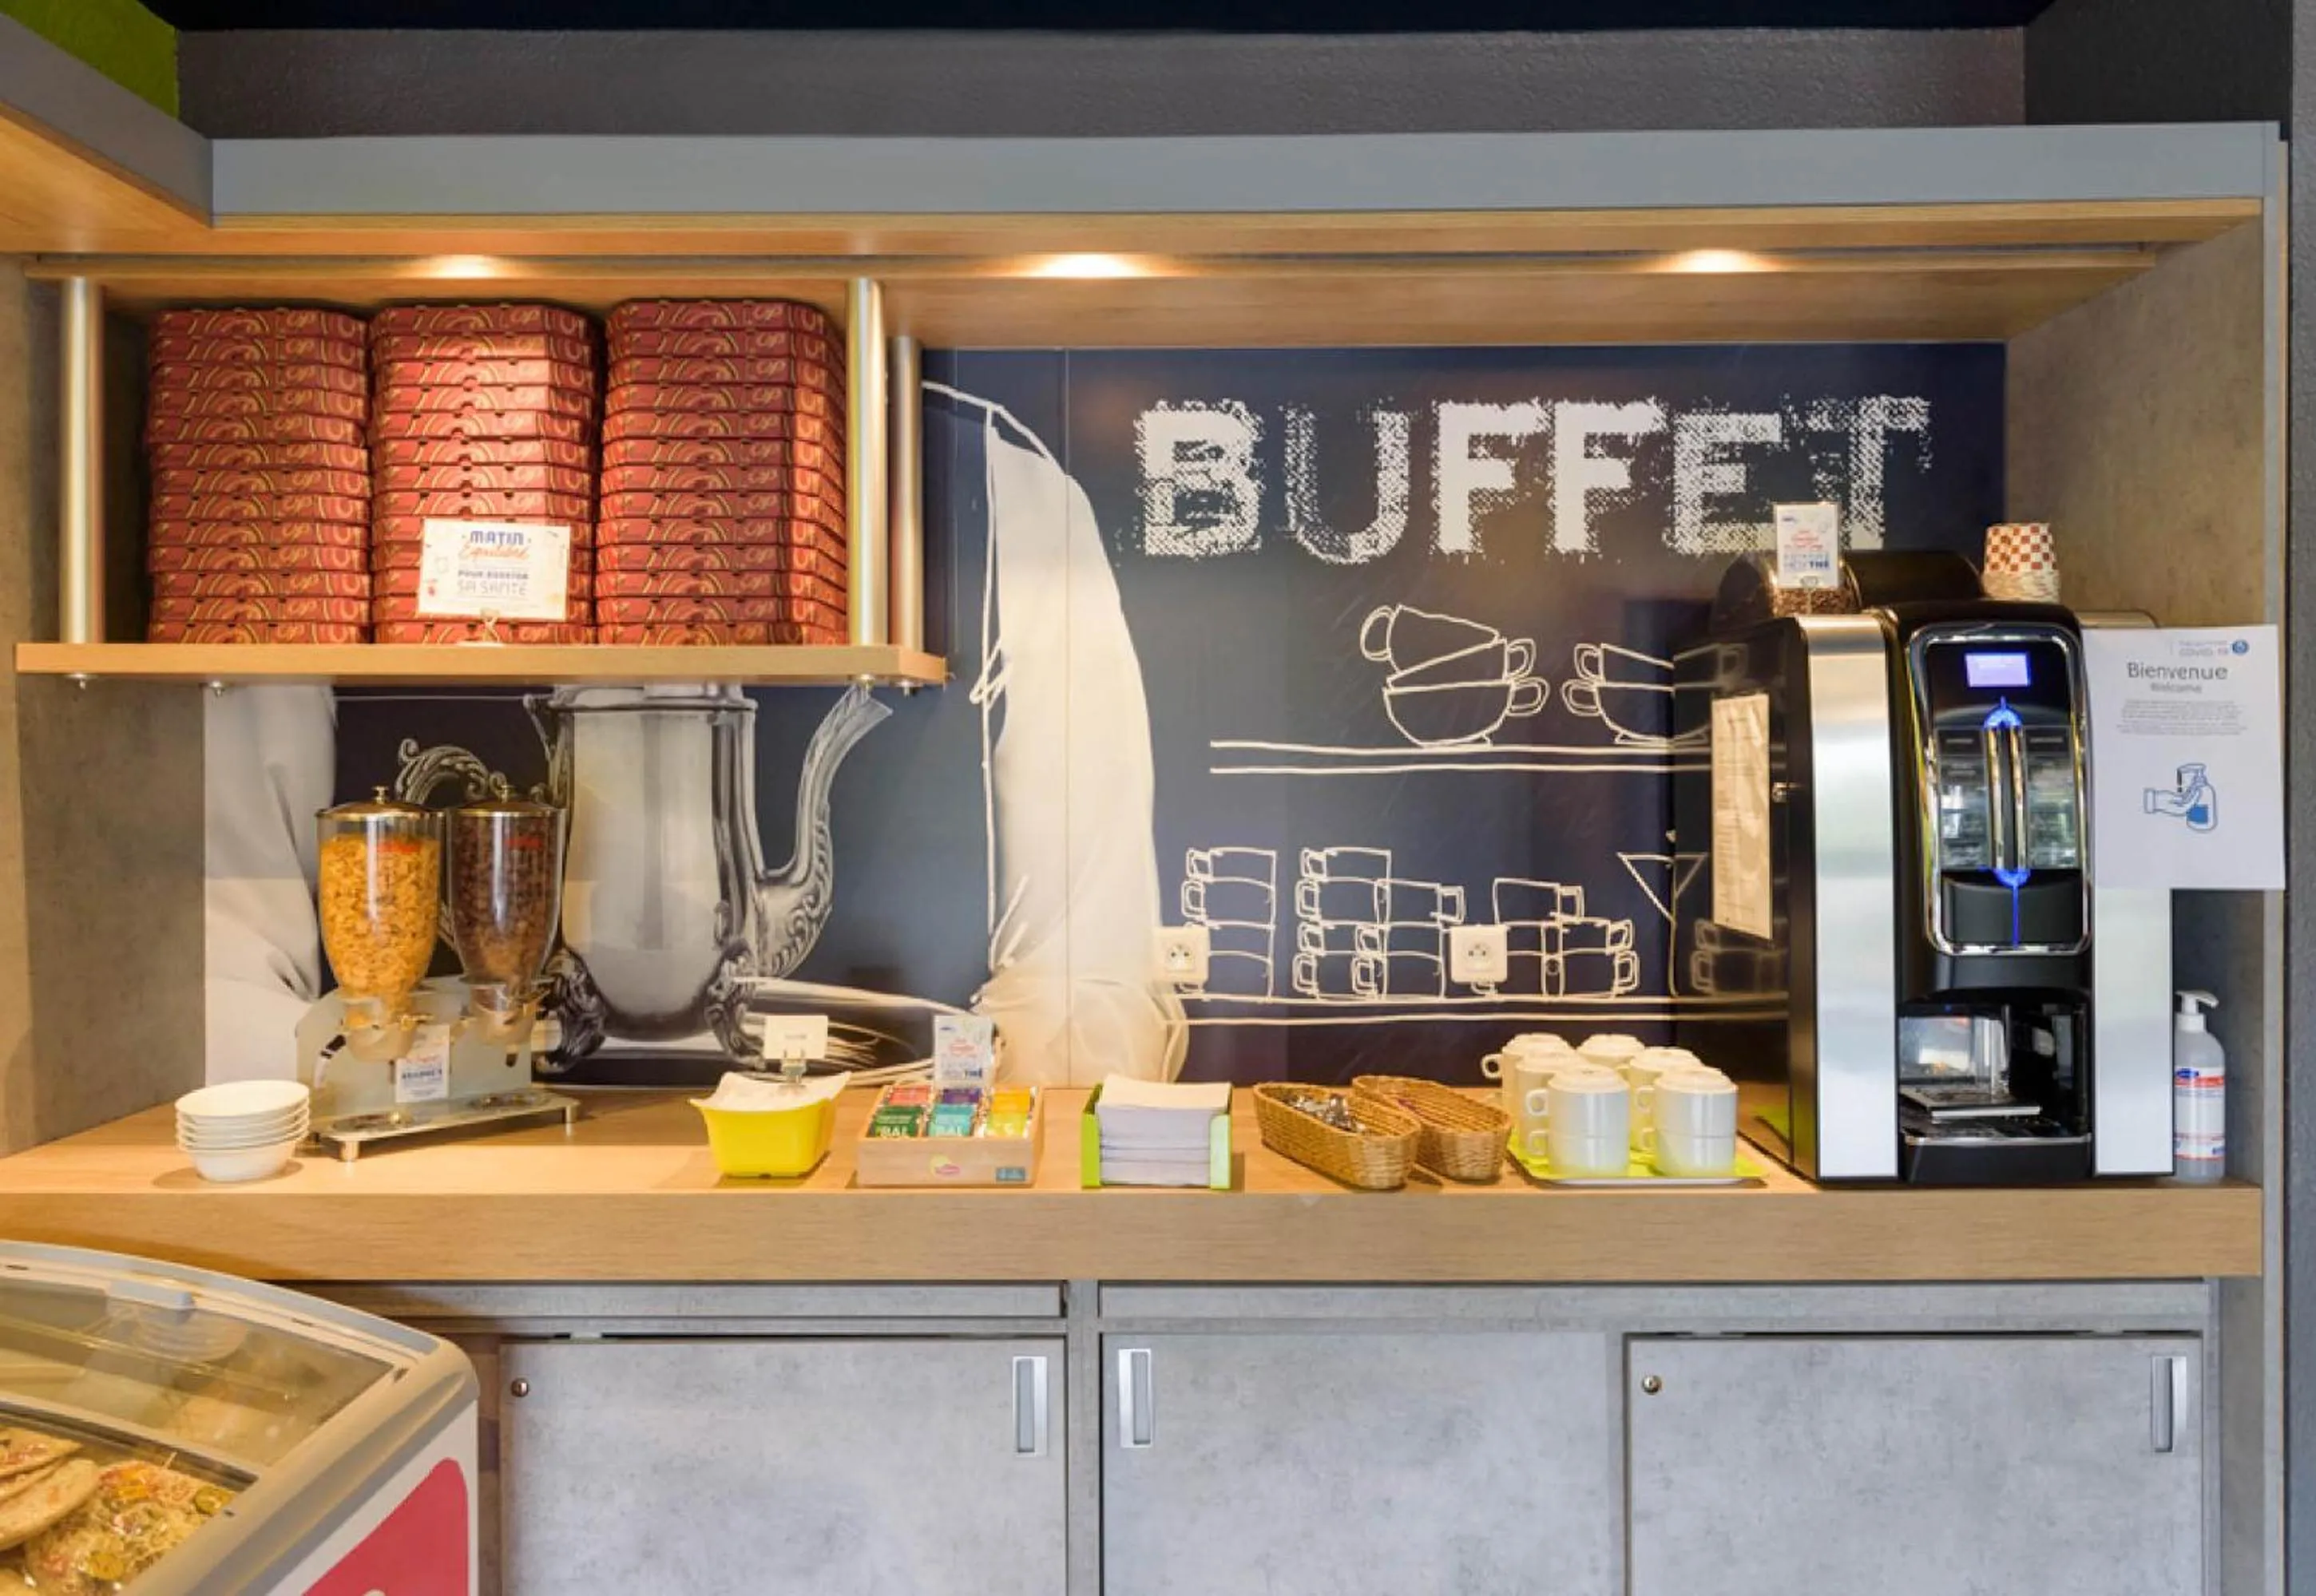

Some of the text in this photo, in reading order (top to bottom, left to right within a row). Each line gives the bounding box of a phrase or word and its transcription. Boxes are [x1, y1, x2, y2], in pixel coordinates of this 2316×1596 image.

[1136, 394, 1930, 565] BUFFET
[470, 530, 525, 546] MATIN
[2128, 662, 2228, 680] Bienvenue
